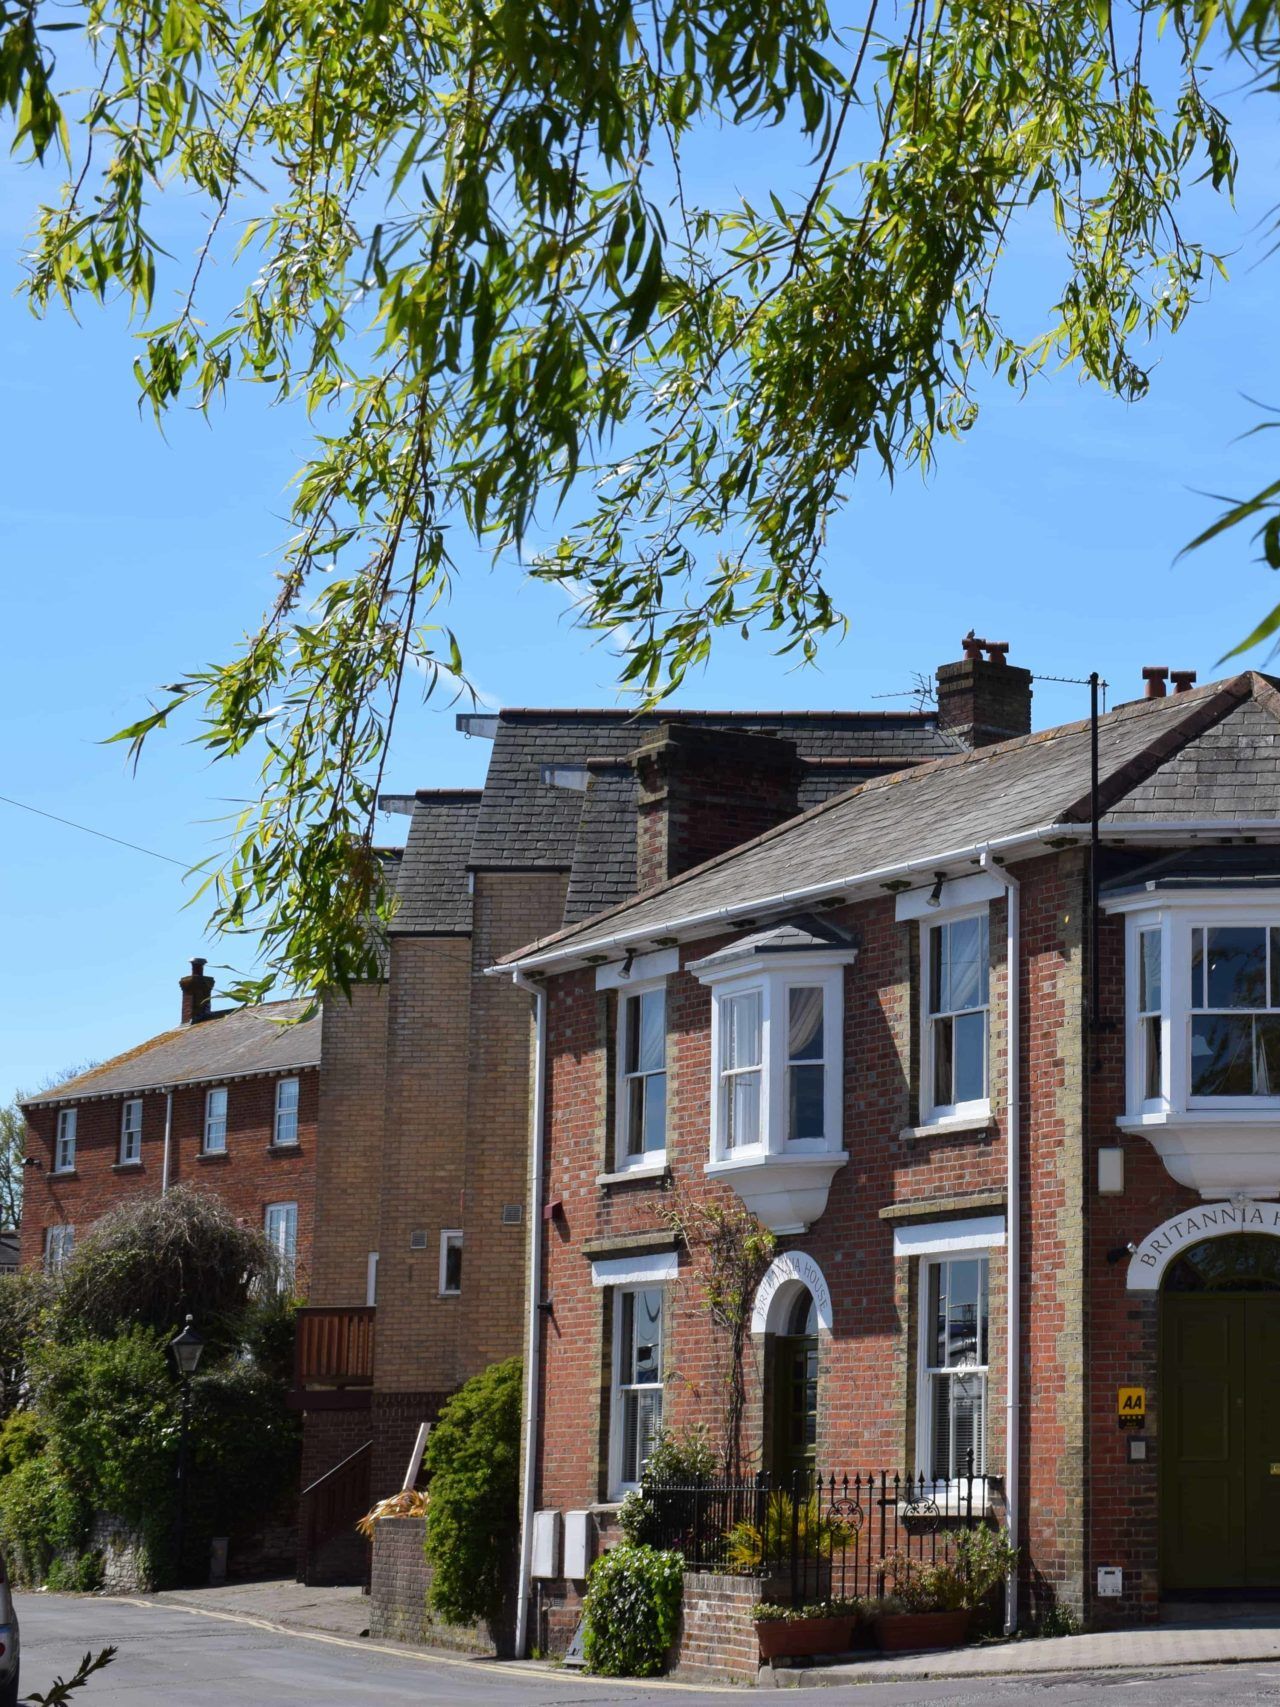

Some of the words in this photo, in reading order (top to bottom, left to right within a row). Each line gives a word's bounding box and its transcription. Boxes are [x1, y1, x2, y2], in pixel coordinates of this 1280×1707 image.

[1140, 1208, 1264, 1268] BRITANNIA
[804, 1262, 828, 1313] HOUSE
[1122, 1395, 1142, 1410] AA
